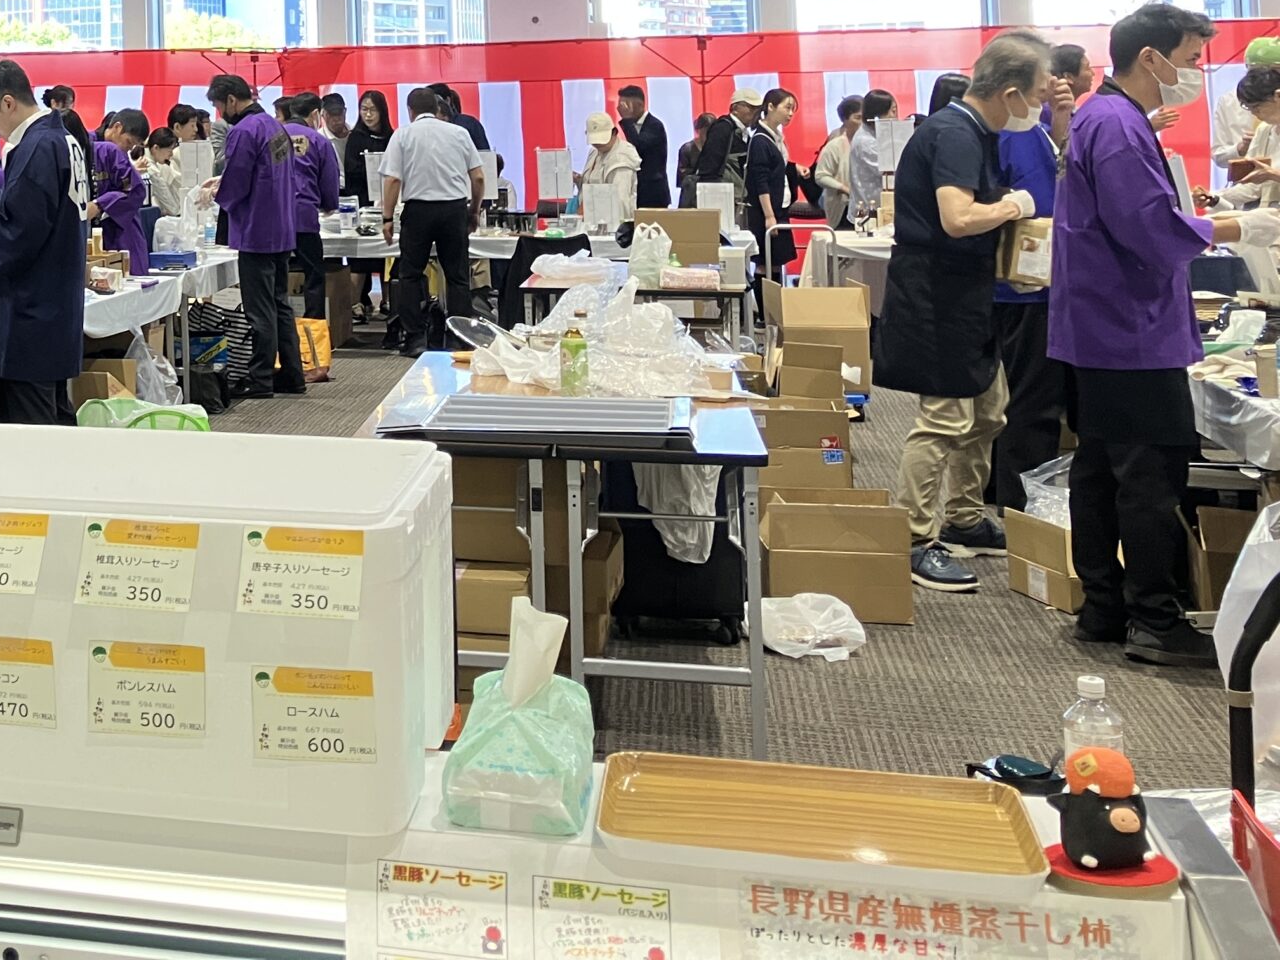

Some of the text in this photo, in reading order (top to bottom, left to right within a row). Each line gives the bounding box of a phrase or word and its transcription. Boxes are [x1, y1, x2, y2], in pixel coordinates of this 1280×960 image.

[96, 555, 179, 569] 椎茸入りソーセージ
[252, 561, 350, 577] 唐辛子入りソーセージ
[126, 586, 162, 602] 350
[291, 594, 328, 610] 350
[287, 706, 340, 718] ロースハム
[140, 712, 175, 729] 500
[308, 737, 345, 753] 600
[393, 865, 505, 891] 黒豚ソーセージ
[552, 881, 668, 908] 黒豚ソーセージ
[618, 907, 668, 920] (バジル入り)
